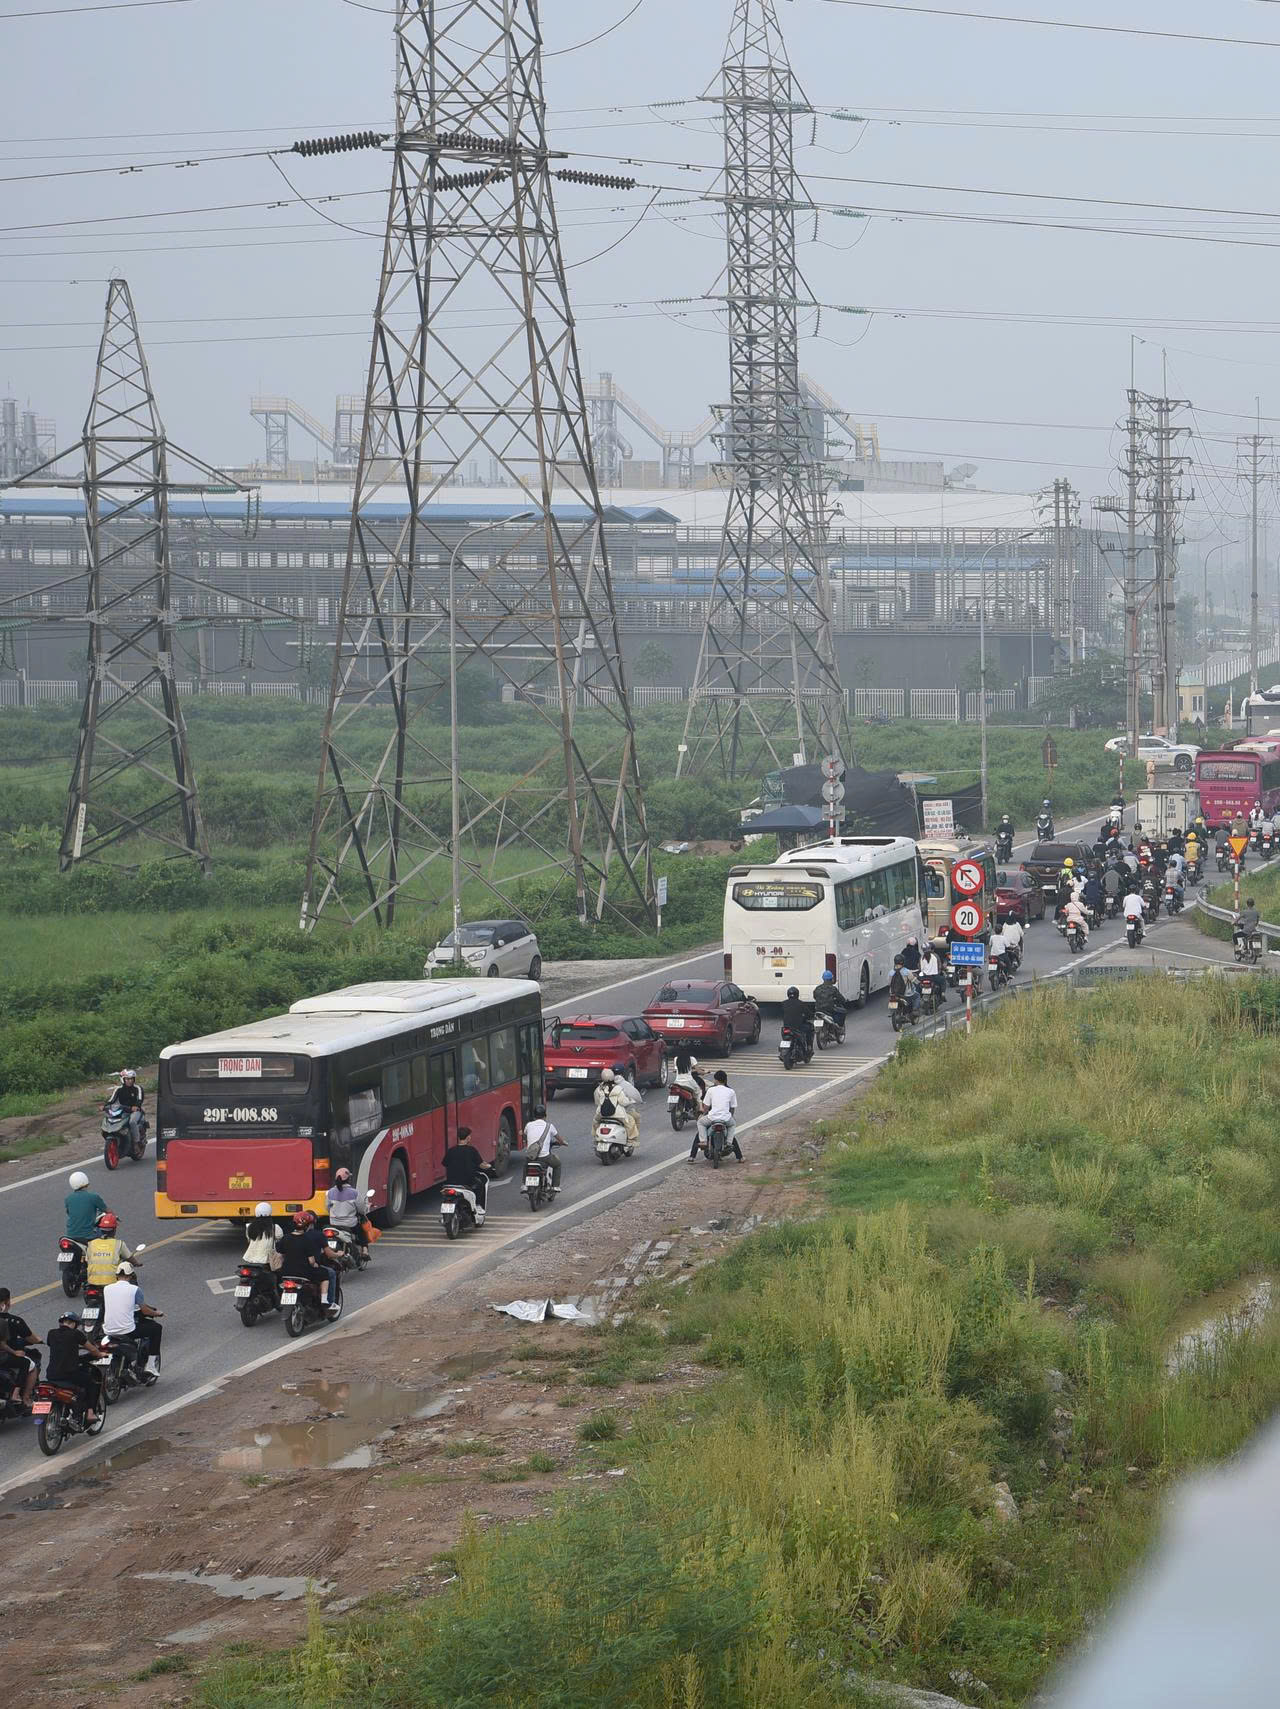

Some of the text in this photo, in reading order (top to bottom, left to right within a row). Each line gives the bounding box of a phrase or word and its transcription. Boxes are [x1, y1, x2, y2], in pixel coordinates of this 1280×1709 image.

[960, 911, 974, 926] 20
[756, 946, 766, 955] 98
[203, 1107, 278, 1122] 29F-008.88
